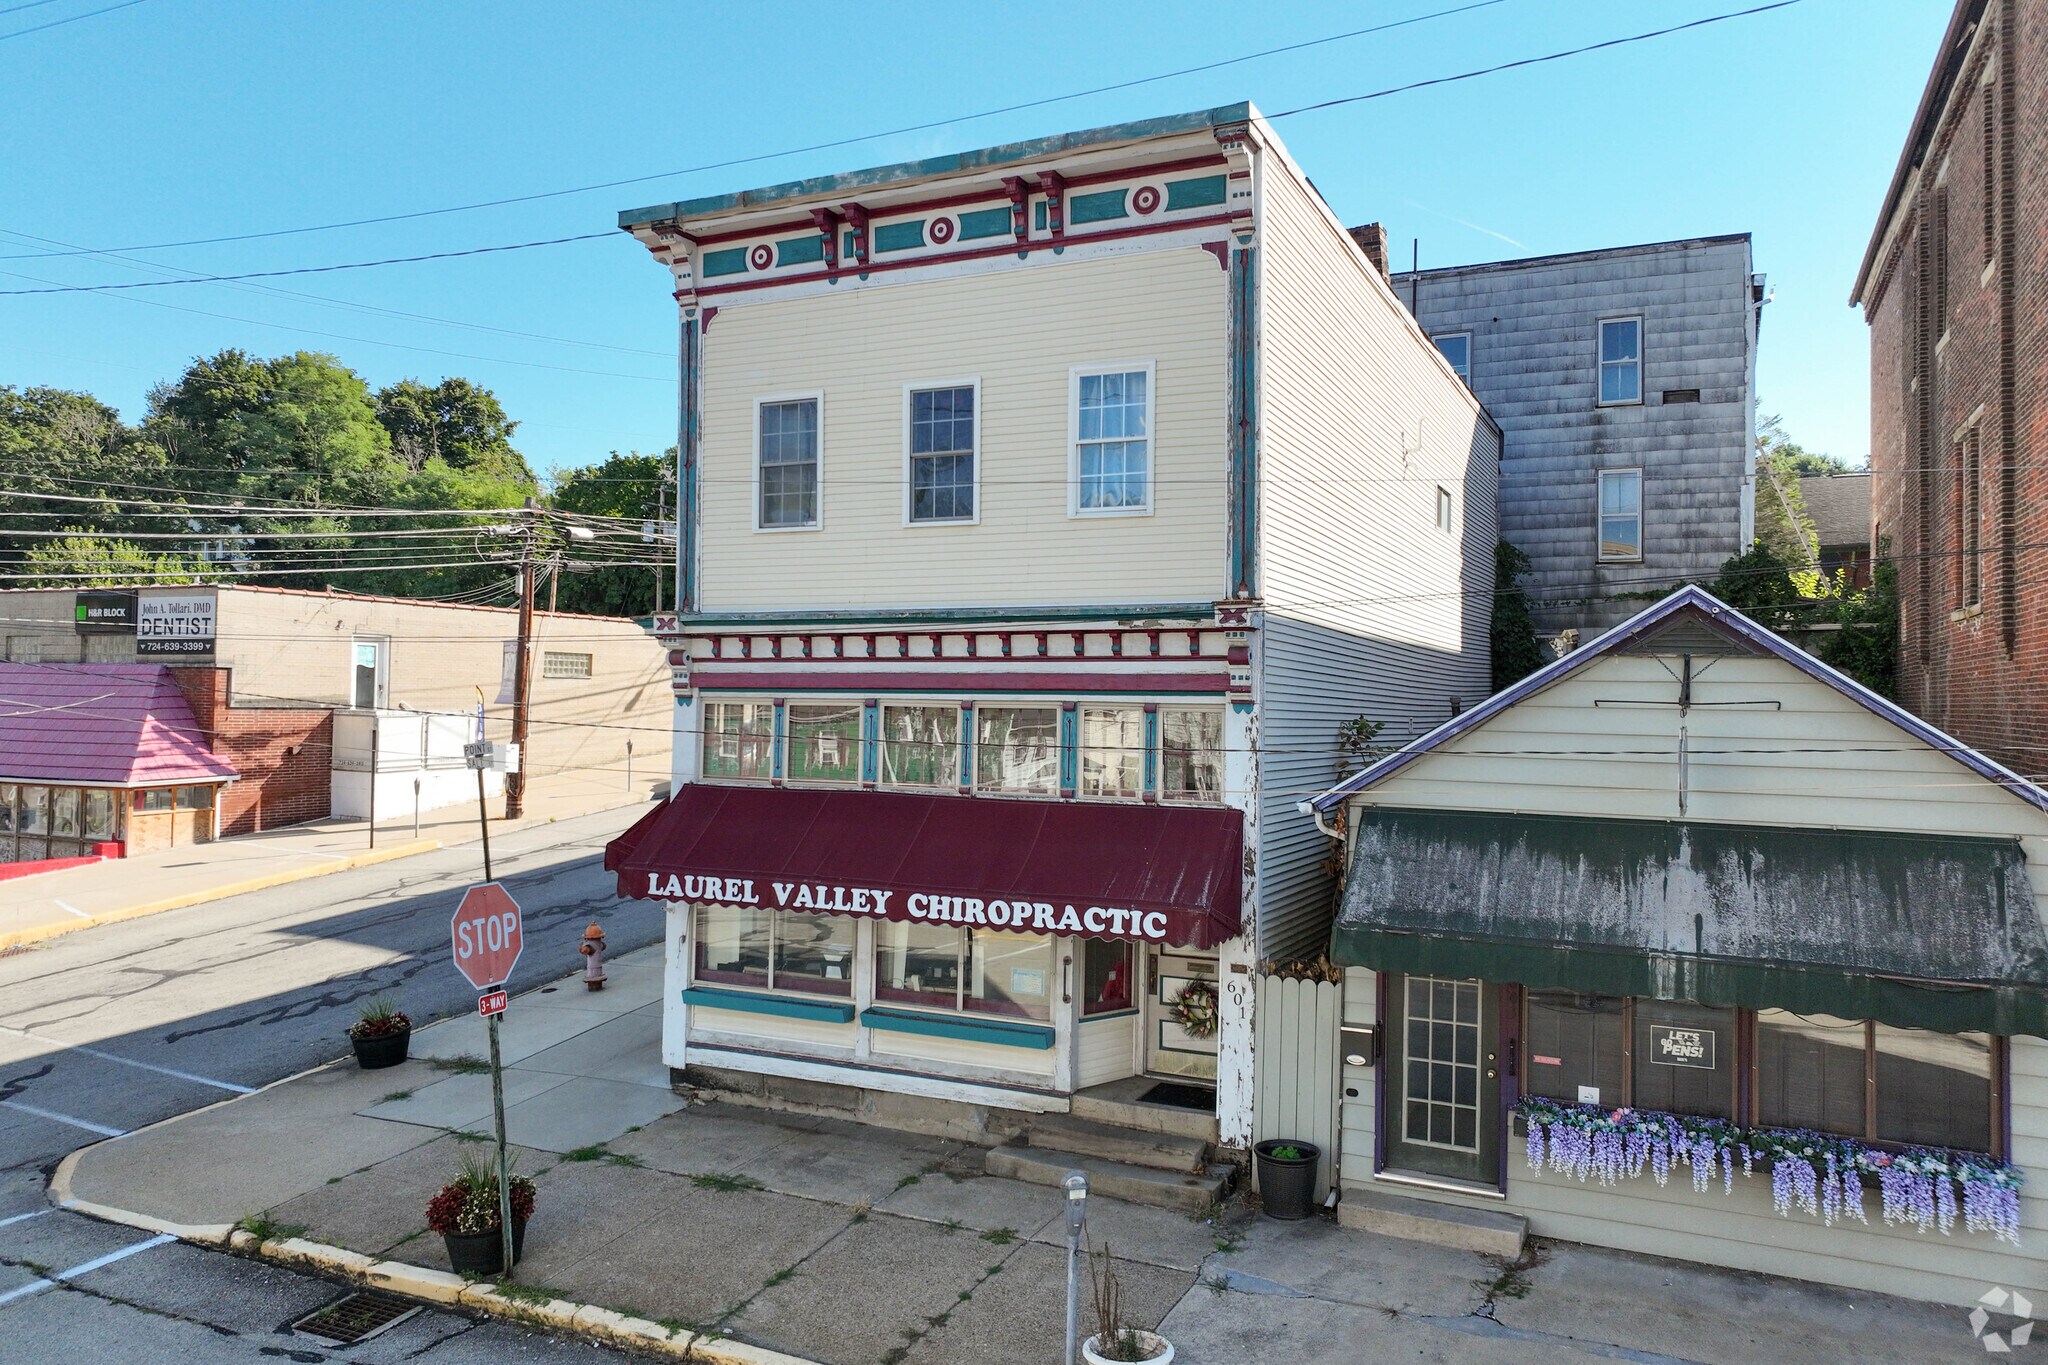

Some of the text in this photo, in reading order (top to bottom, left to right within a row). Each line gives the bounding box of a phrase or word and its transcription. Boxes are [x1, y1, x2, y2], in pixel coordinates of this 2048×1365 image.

[88, 607, 126, 617] H&R BLOCK
[141, 603, 158, 616] John
[160, 604, 166, 614] A.
[193, 602, 211, 613] DMD
[142, 617, 212, 636] DENTIST
[147, 642, 204, 651] 724-639-3399
[464, 743, 486, 756] POINT
[647, 872, 1168, 938] LAUREL VALLEY CHIROPRACTIC
[458, 912, 517, 959] STOP
[481, 995, 506, 1012] 3-WAY
[1227, 980, 1245, 1019] 601
[1660, 1038, 1673, 1046] GO
[1669, 1030, 1700, 1041] LET'S
[1662, 1044, 1704, 1058] PENS!
